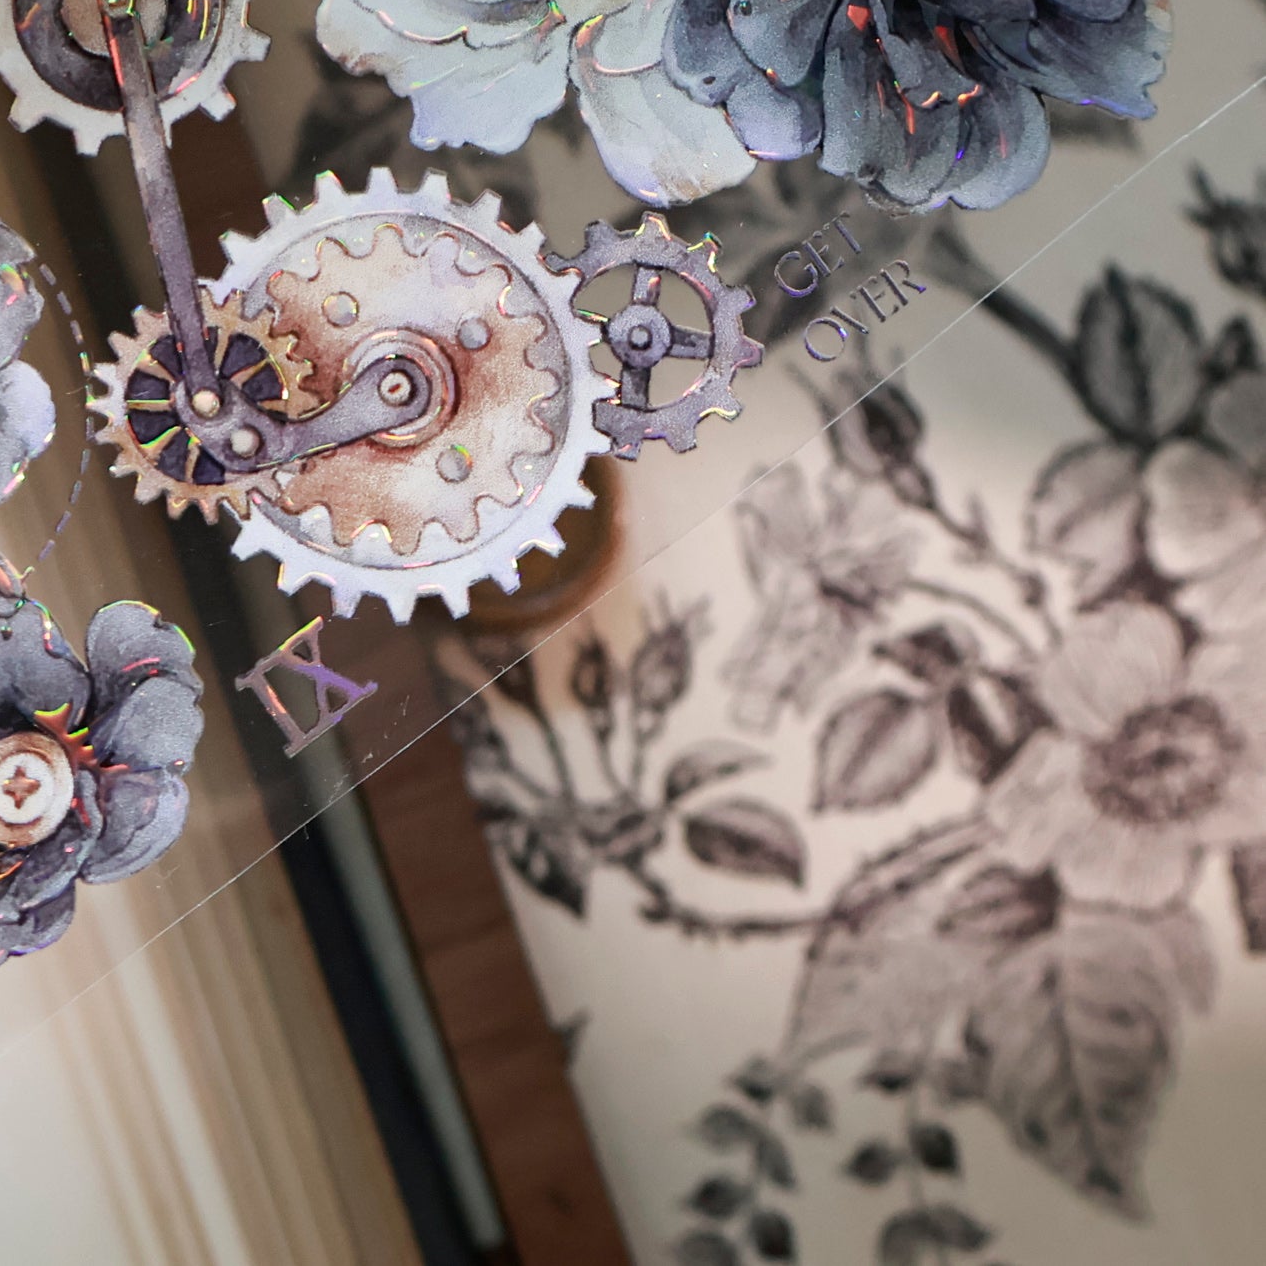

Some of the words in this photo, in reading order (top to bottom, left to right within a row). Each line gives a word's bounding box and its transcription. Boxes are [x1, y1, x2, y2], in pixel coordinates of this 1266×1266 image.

[774, 210, 862, 298] GET
[804, 259, 927, 362] OVER
[235, 615, 378, 759] IX
